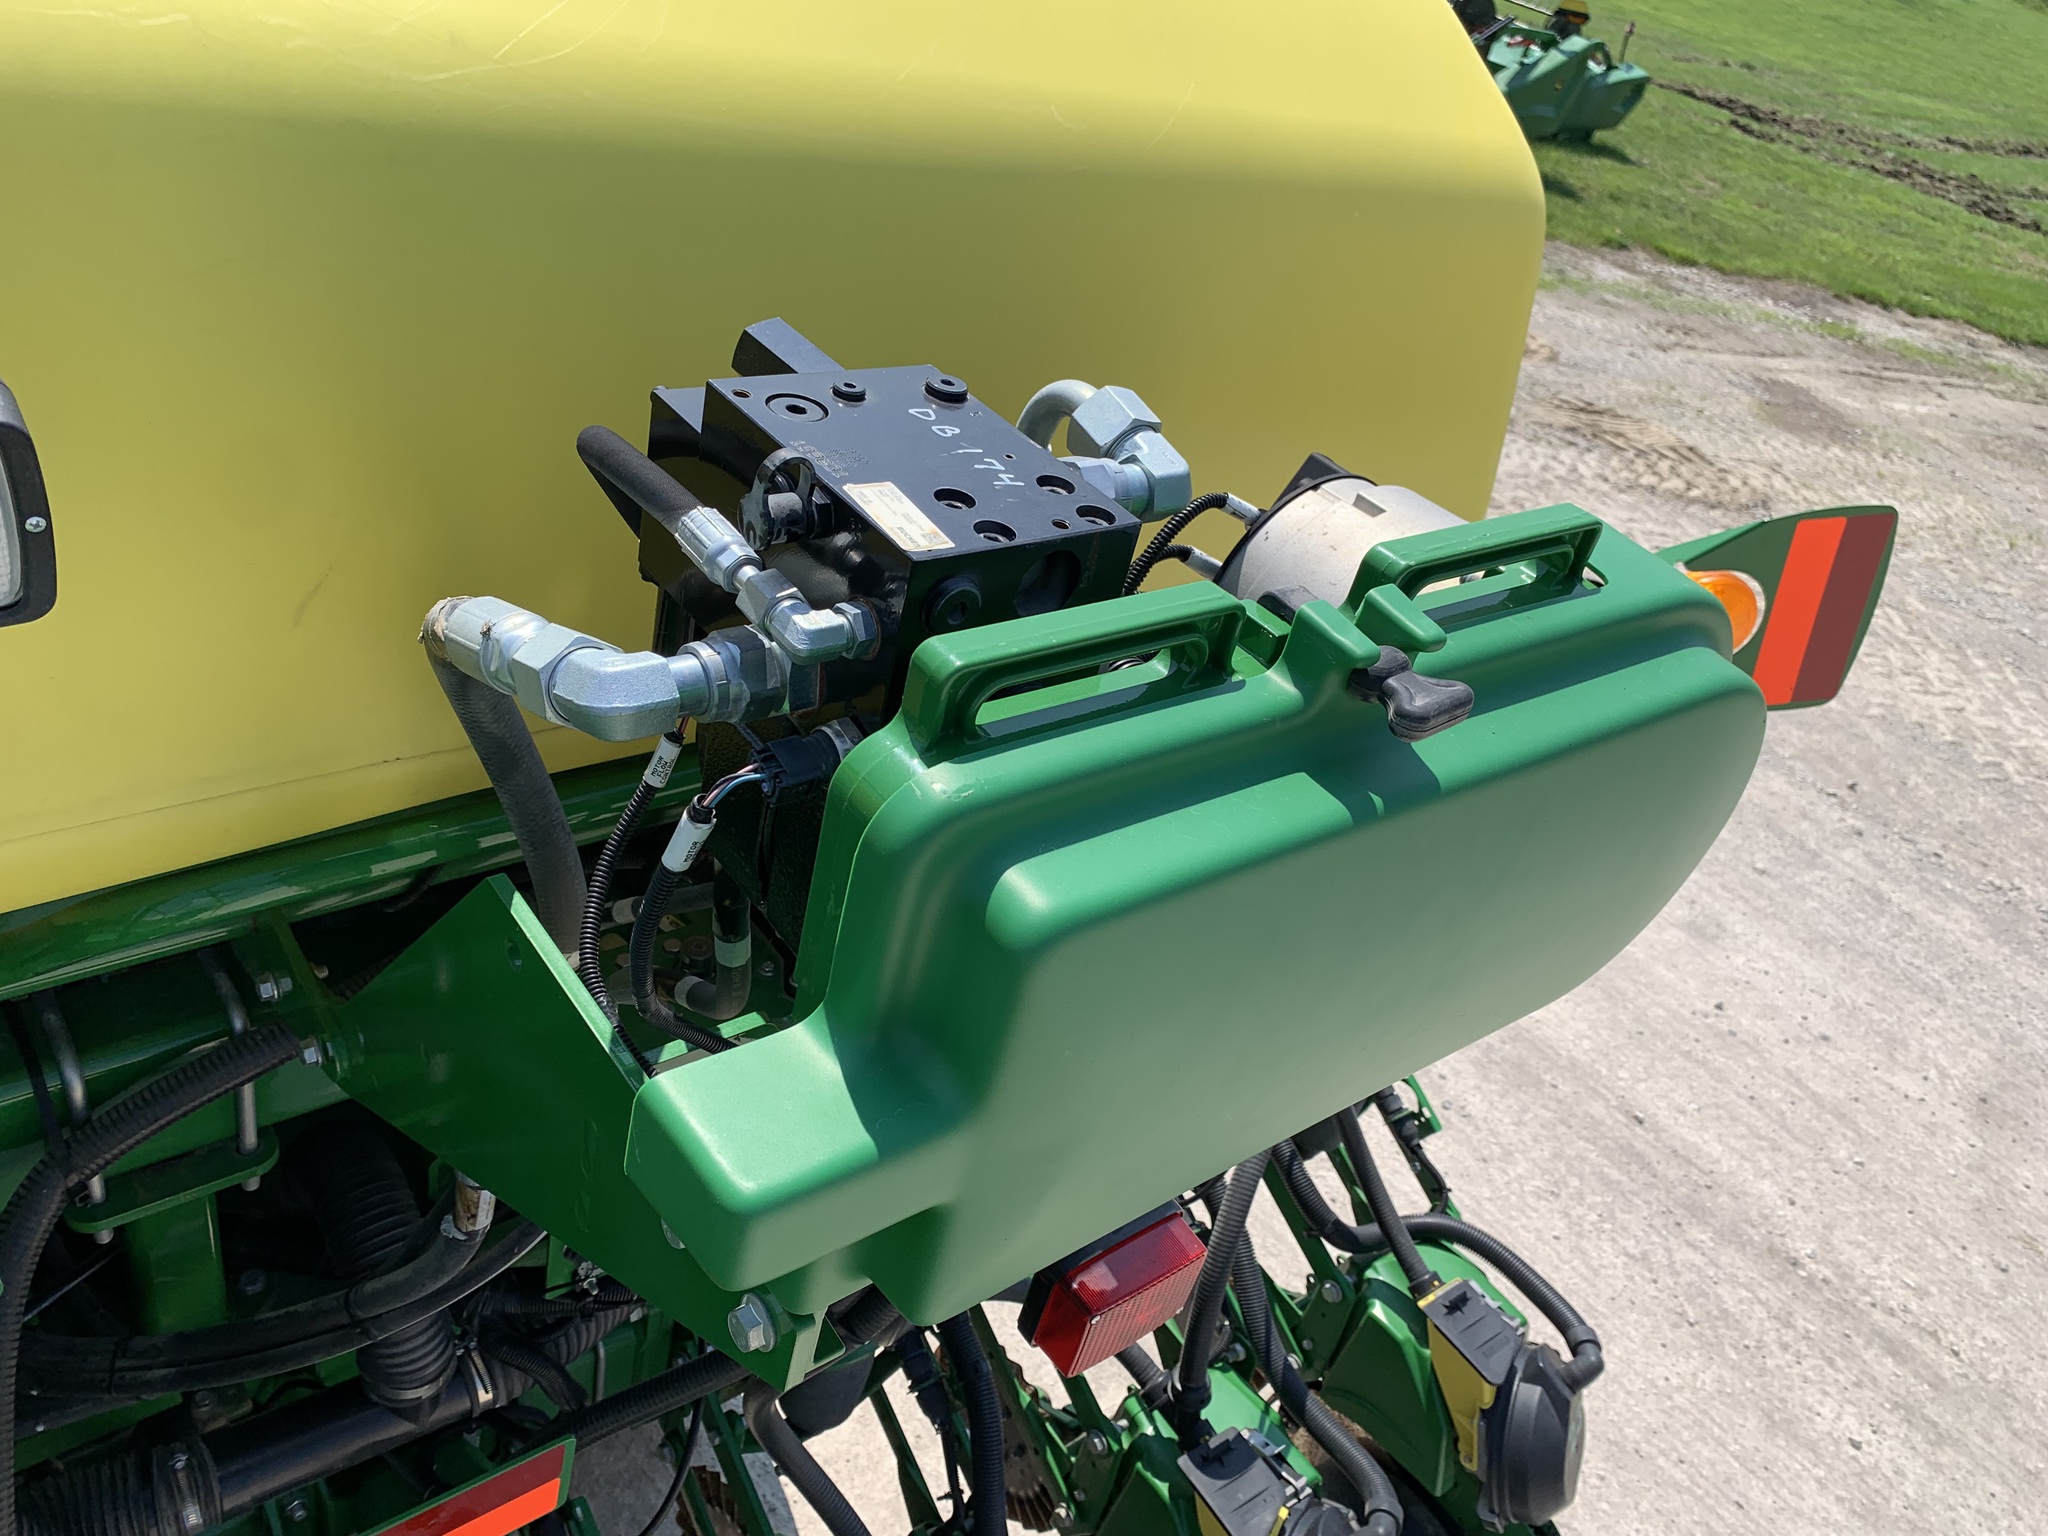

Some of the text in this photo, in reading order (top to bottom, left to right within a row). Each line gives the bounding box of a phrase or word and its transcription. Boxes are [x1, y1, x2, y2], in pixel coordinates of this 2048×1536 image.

[650, 755, 664, 778] MOTOR
[656, 760, 669, 778] FLOW
[683, 841, 699, 863] MOTOR
